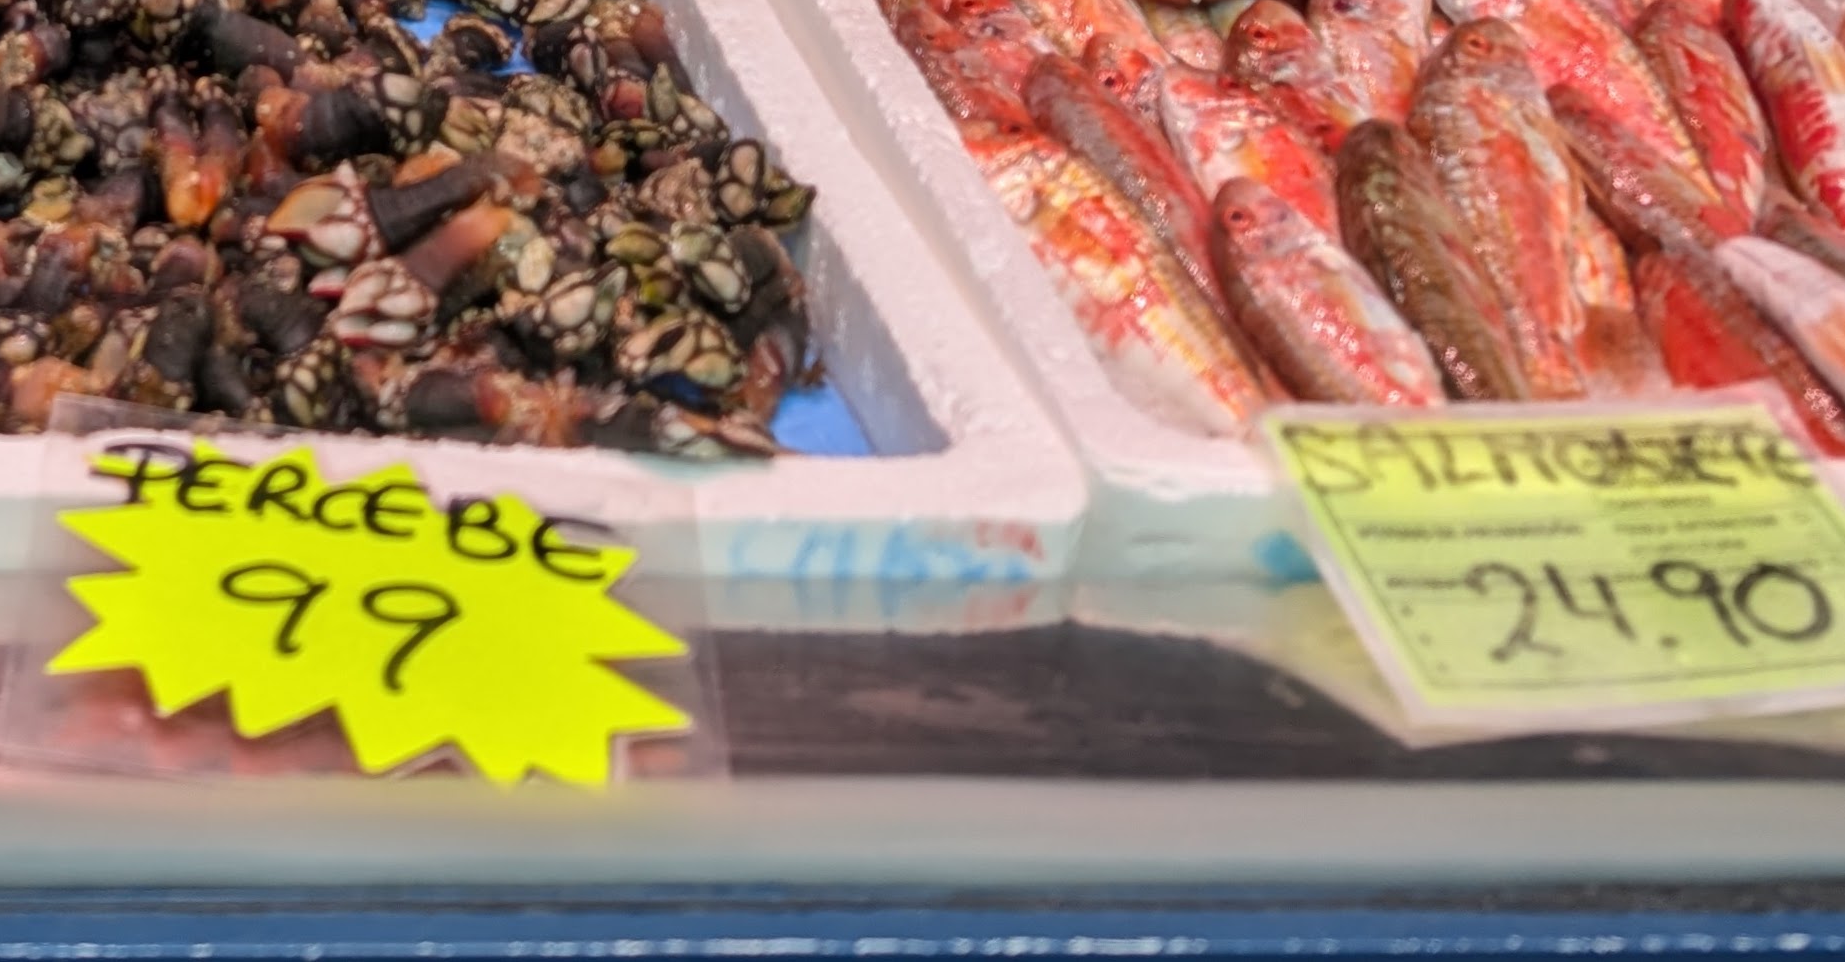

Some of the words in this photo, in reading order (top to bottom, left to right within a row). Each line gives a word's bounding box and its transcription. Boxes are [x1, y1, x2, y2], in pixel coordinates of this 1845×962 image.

[88, 443, 615, 582] PERCEBE
[219, 563, 462, 694] 99
[1463, 561, 1832, 662] 24.90
